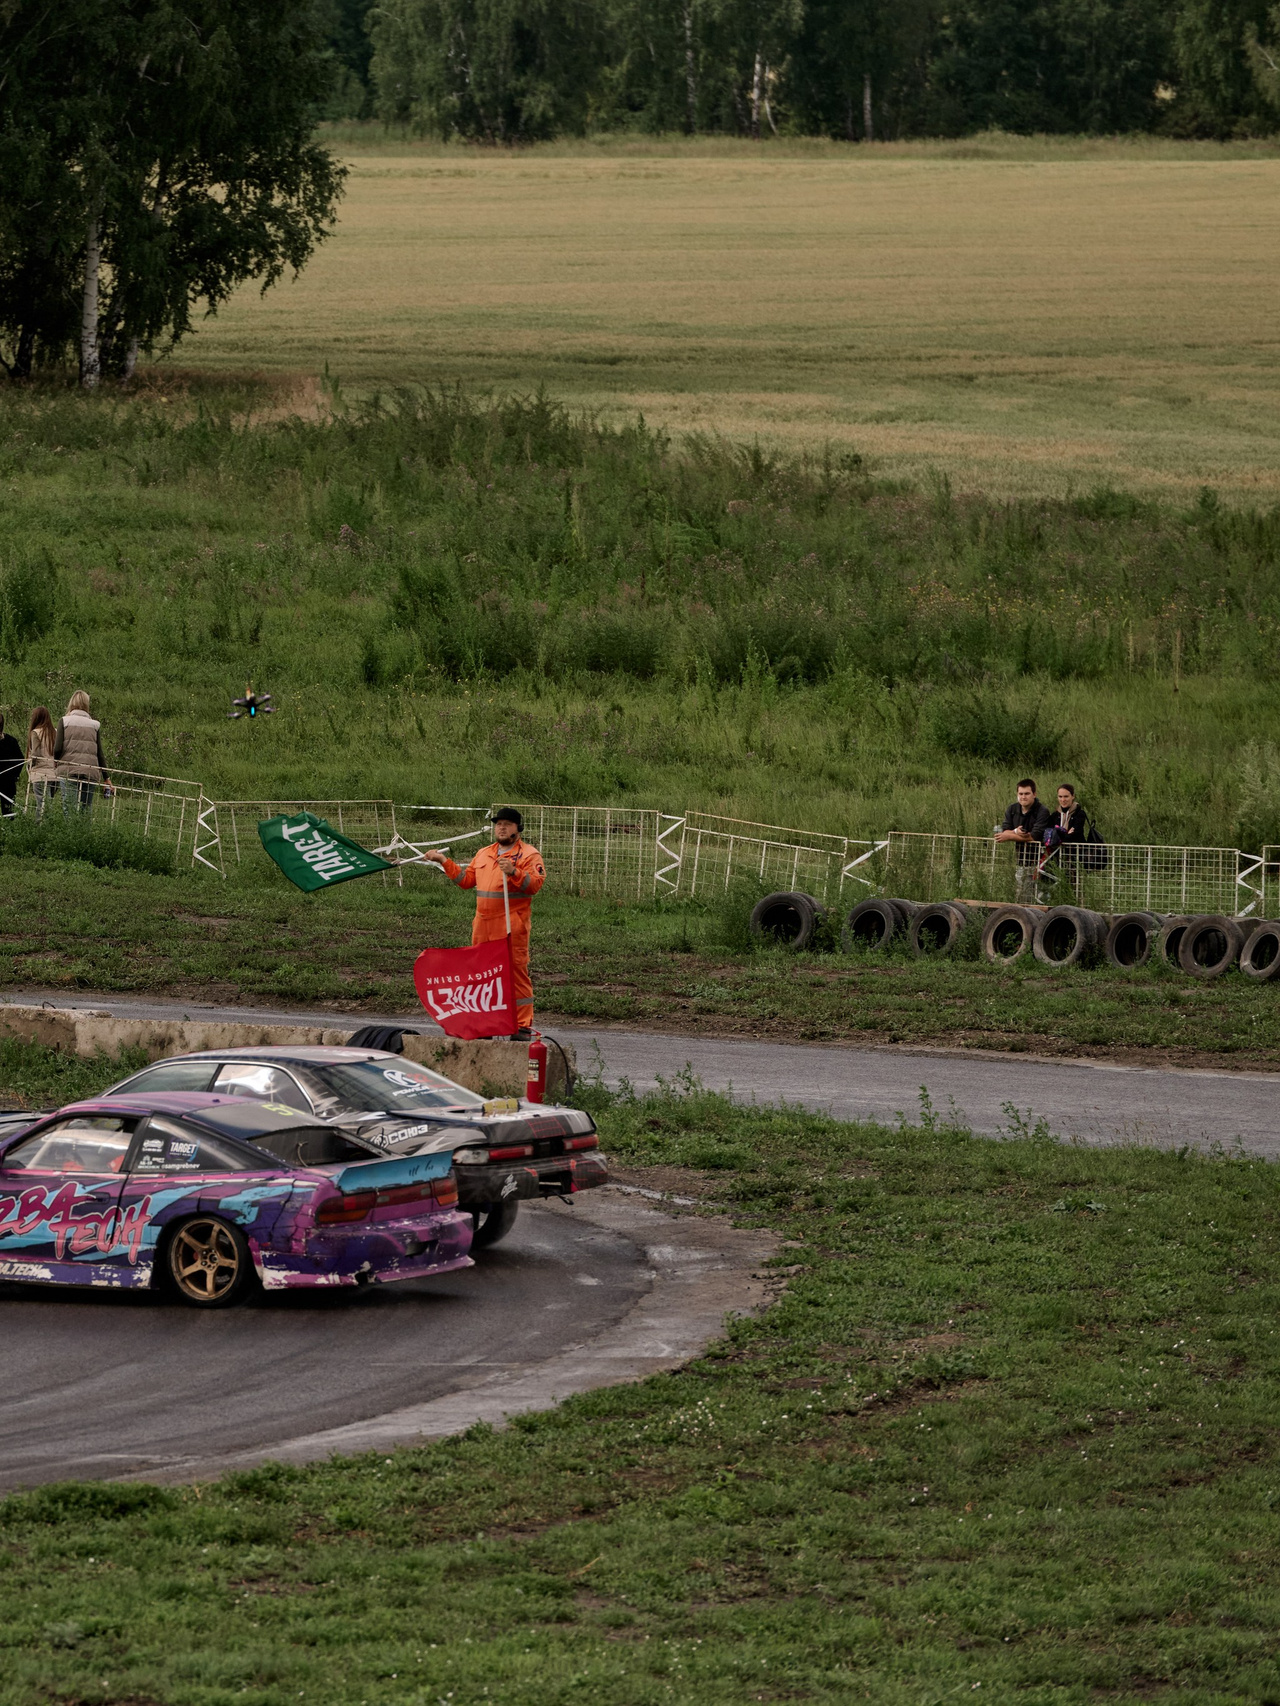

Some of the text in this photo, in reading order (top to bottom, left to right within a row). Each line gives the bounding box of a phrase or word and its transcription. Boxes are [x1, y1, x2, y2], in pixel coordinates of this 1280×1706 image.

[282, 822, 355, 881] TARGT
[426, 964, 503, 985] ENERGY DRINK
[170, 1141, 197, 1154] TARGET
[48, 1195, 153, 1265] TECH
